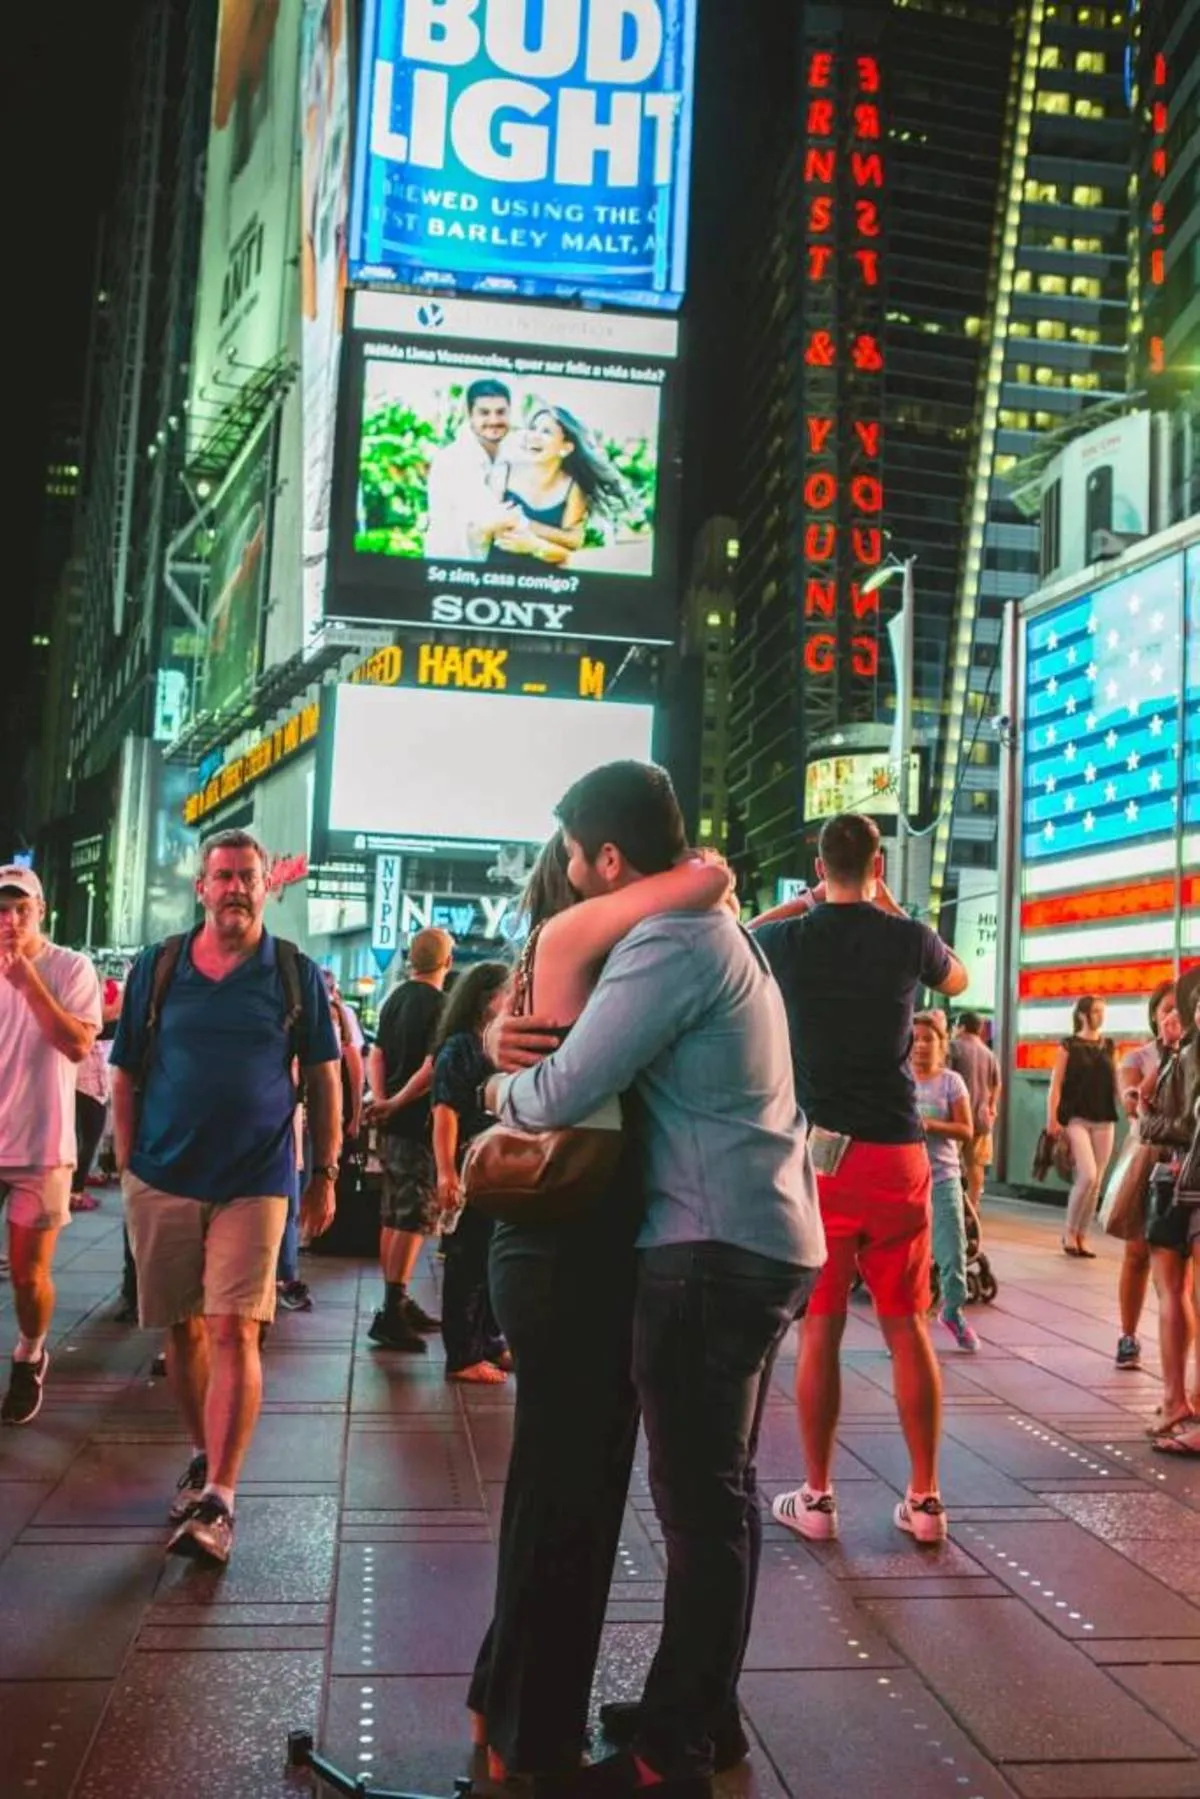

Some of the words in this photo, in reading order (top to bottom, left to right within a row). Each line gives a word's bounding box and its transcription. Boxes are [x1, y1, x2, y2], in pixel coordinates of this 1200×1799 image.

[402, 0, 663, 84] BUD
[369, 58, 682, 187] LIGHT
[804, 51, 836, 282] ERNST
[491, 196, 584, 223] USING
[593, 205, 640, 225] THE
[427, 217, 548, 249] BARLEY
[561, 232, 638, 255] MALT,
[804, 330, 836, 367] &
[803, 415, 837, 675] YOUNG
[427, 566, 447, 582] Se
[448, 566, 480, 587] sim,
[482, 572, 515, 588] casa
[517, 574, 580, 594] comigo?
[431, 593, 574, 630] SONY
[417, 643, 508, 689] HACK
[379, 858, 396, 946] NYPD
